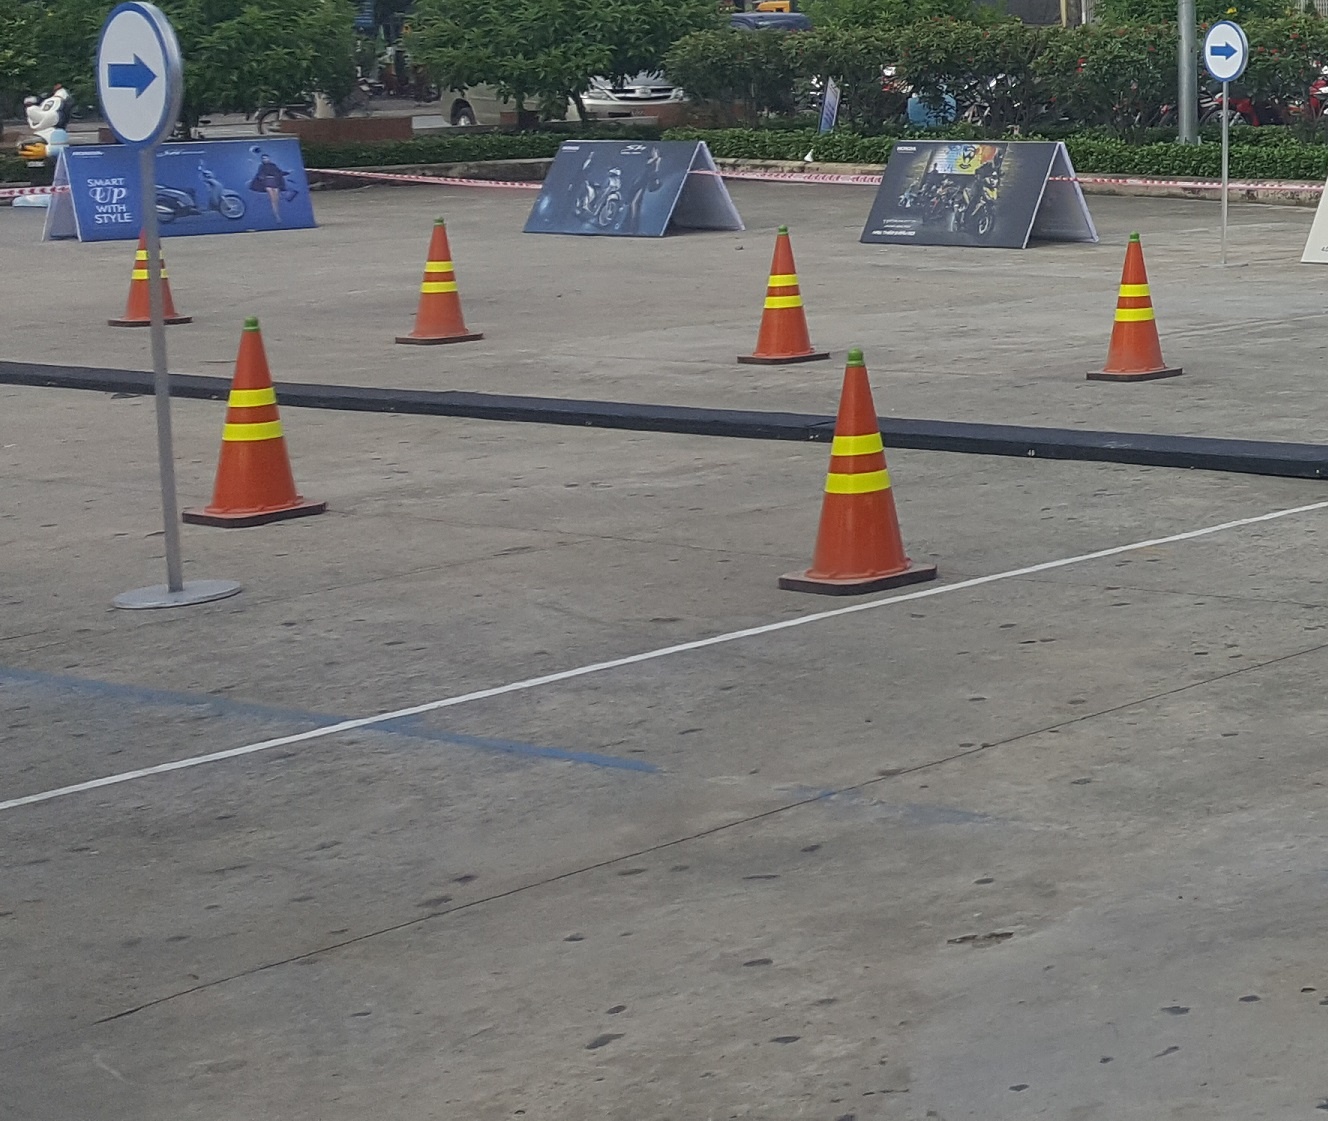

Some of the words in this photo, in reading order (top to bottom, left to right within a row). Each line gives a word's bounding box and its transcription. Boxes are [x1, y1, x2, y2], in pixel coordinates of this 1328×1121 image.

[87, 177, 126, 188] SMART
[95, 203, 127, 213] WITH
[94, 212, 133, 224] STYLE
